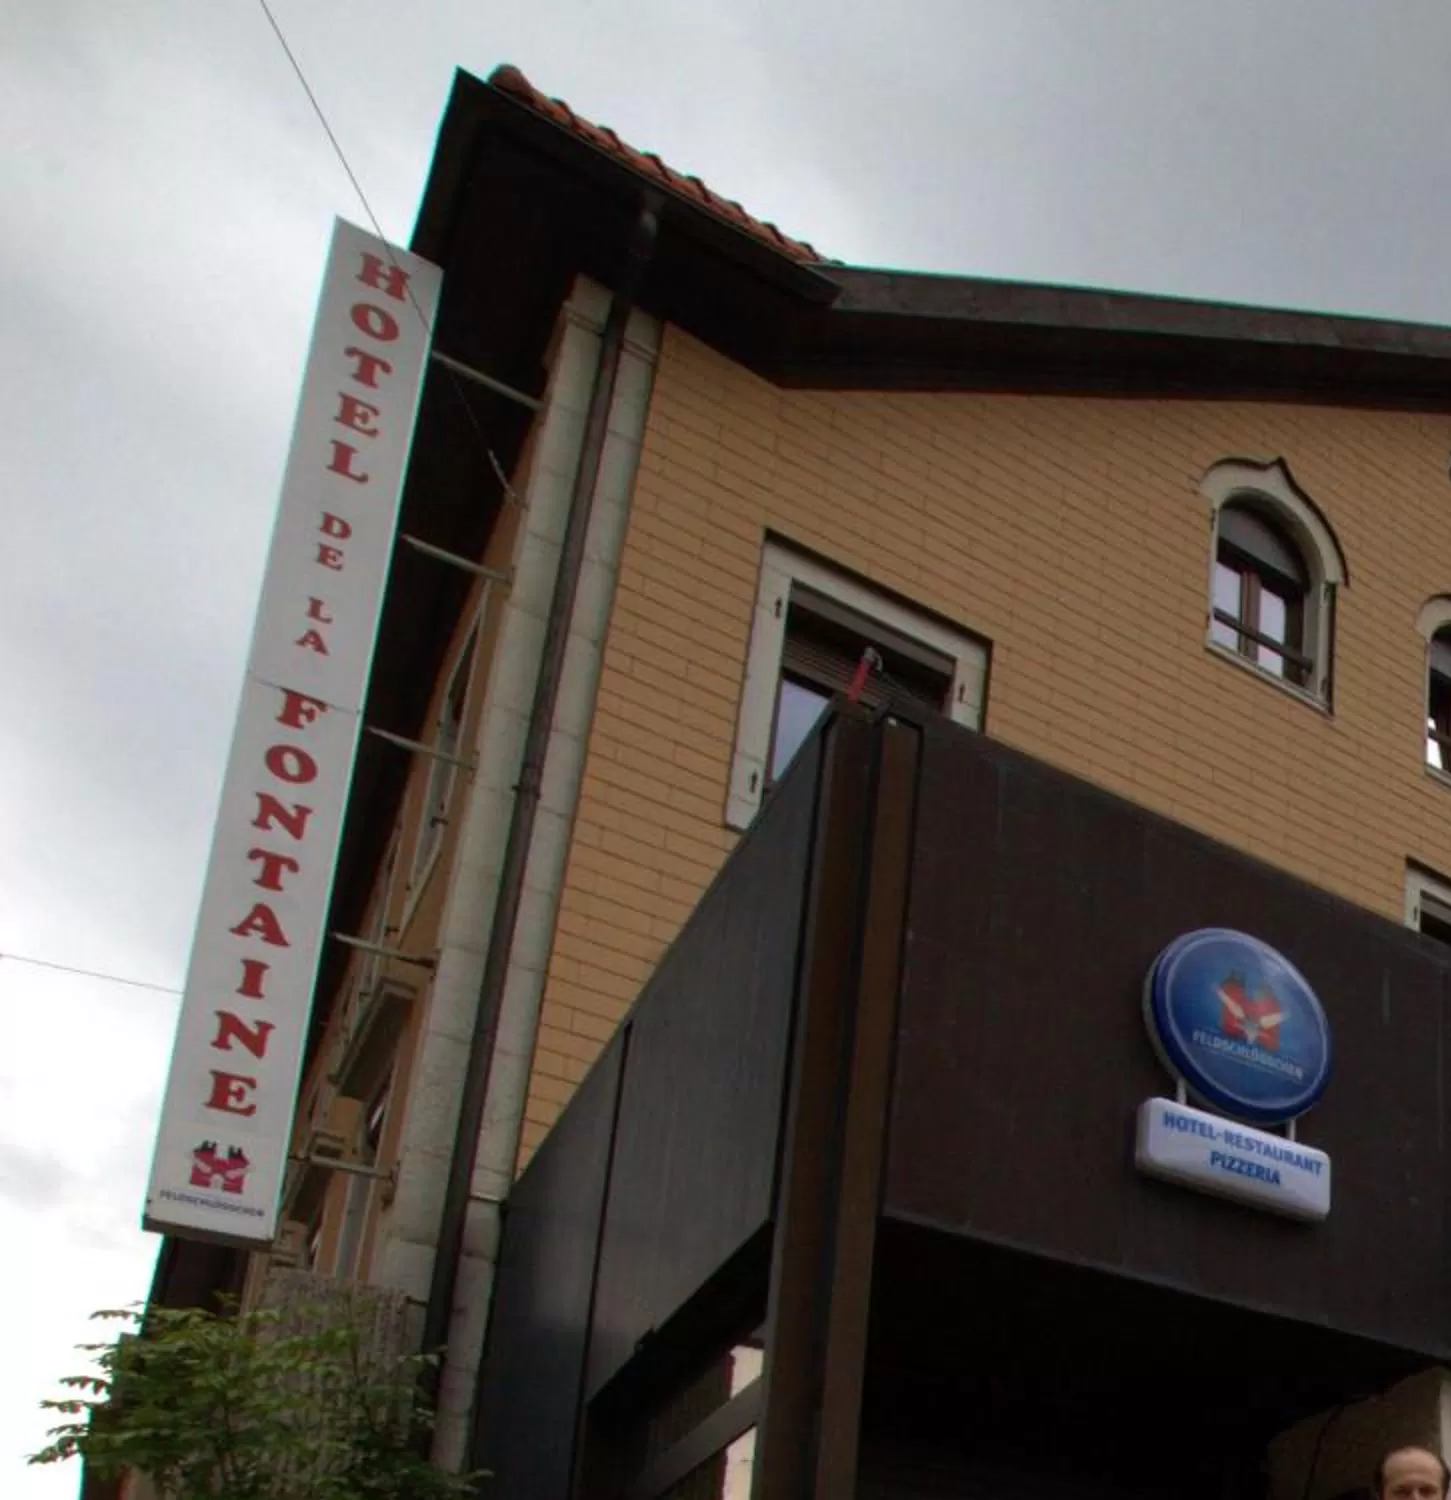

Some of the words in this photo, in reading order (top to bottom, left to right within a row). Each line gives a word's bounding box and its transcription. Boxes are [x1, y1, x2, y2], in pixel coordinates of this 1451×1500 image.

[326, 251, 412, 485] HOTEL
[315, 510, 353, 572] DE
[295, 597, 333, 657] LA
[204, 687, 328, 1119] FONTAINE
[1210, 1150, 1281, 1186] PIZZERIA
